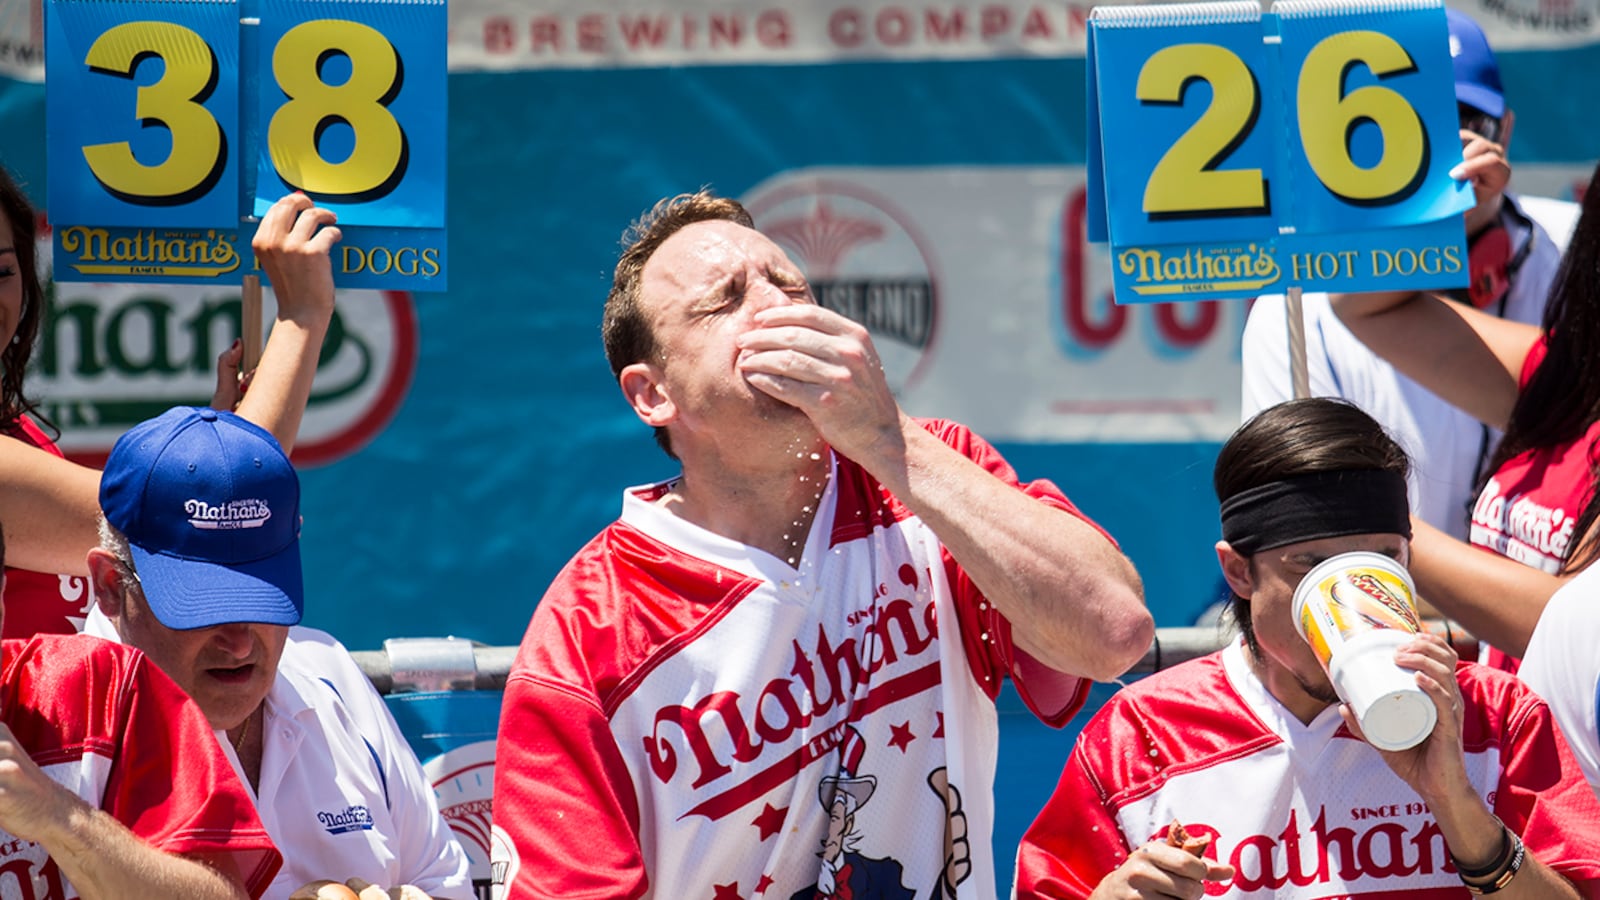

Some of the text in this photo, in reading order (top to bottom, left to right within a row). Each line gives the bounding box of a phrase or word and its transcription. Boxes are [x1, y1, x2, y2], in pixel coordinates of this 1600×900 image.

[481, 3, 1088, 55] BREWING COMPAN
[61, 226, 241, 266] Nathan's
[340, 246, 441, 277] DOGS
[1118, 244, 1463, 282] Nathan's HOT DOGS
[184, 499, 272, 521] Nathan's
[1351, 802, 1431, 820] SINCE 191
[1142, 804, 1459, 897] athan
